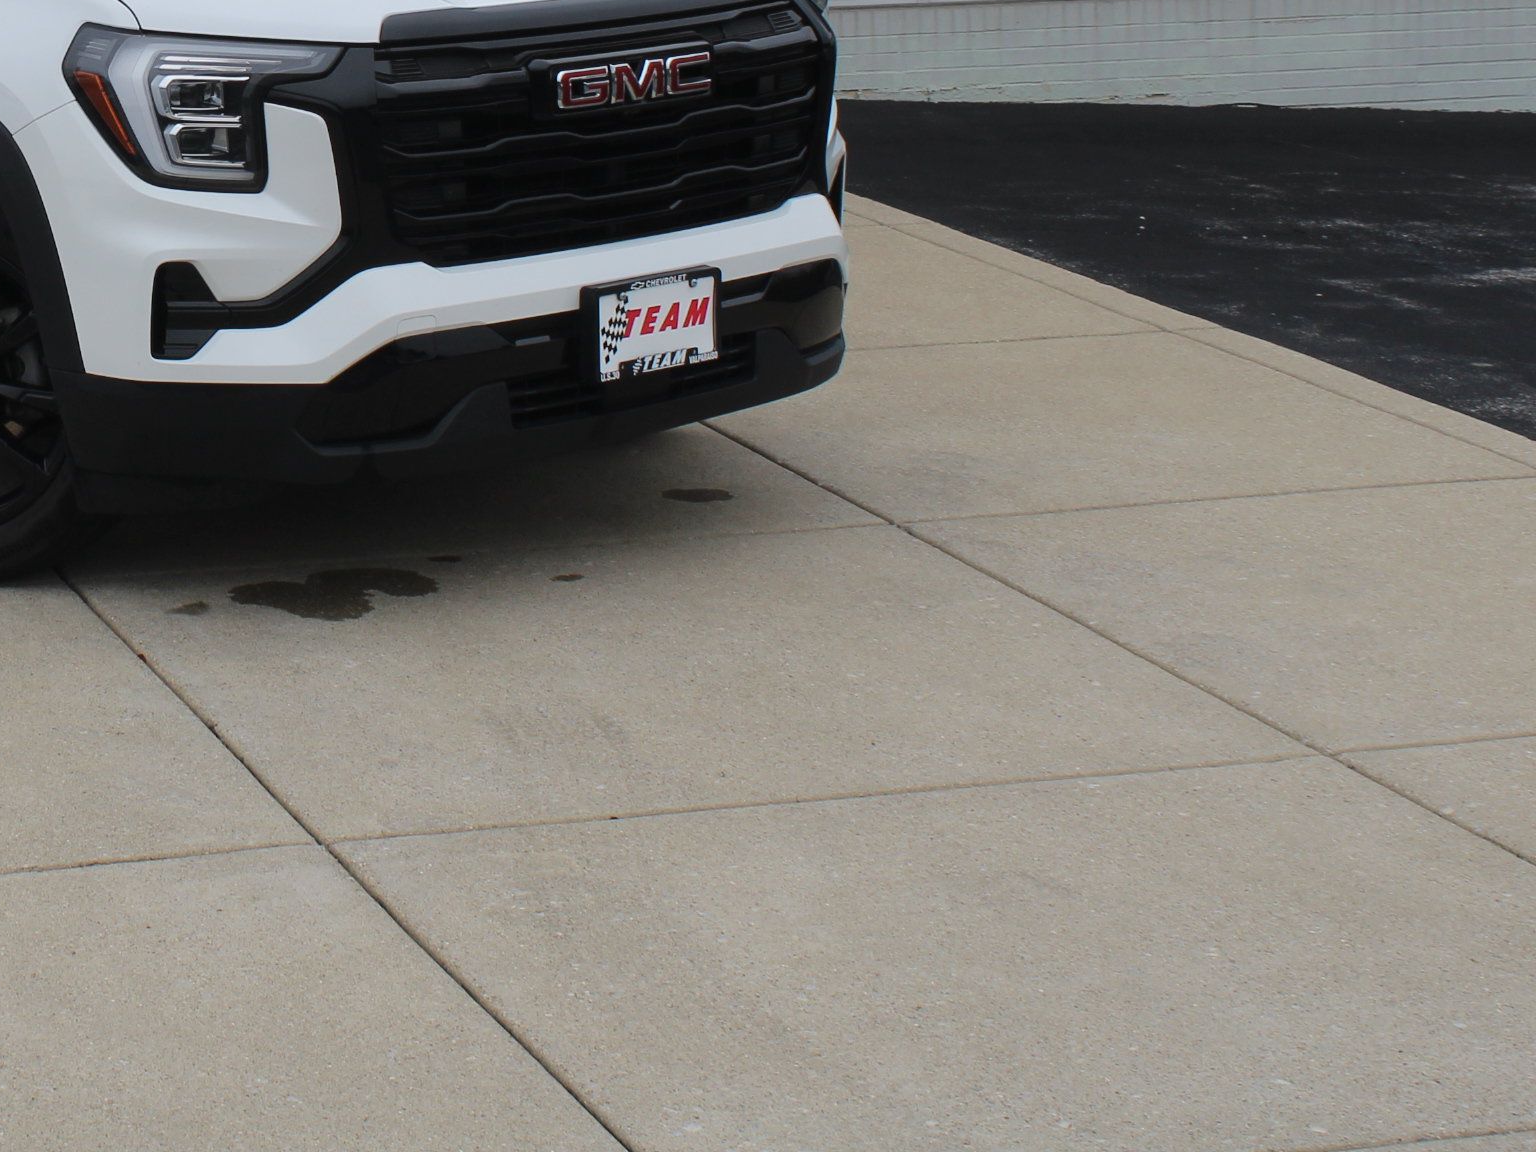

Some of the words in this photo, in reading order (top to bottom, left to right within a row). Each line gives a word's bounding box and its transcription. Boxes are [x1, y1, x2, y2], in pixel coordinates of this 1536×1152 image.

[557, 51, 712, 109] GMC
[645, 274, 687, 288] CHEVROLET
[623, 297, 711, 339] TEAM
[642, 349, 687, 373] TEAM
